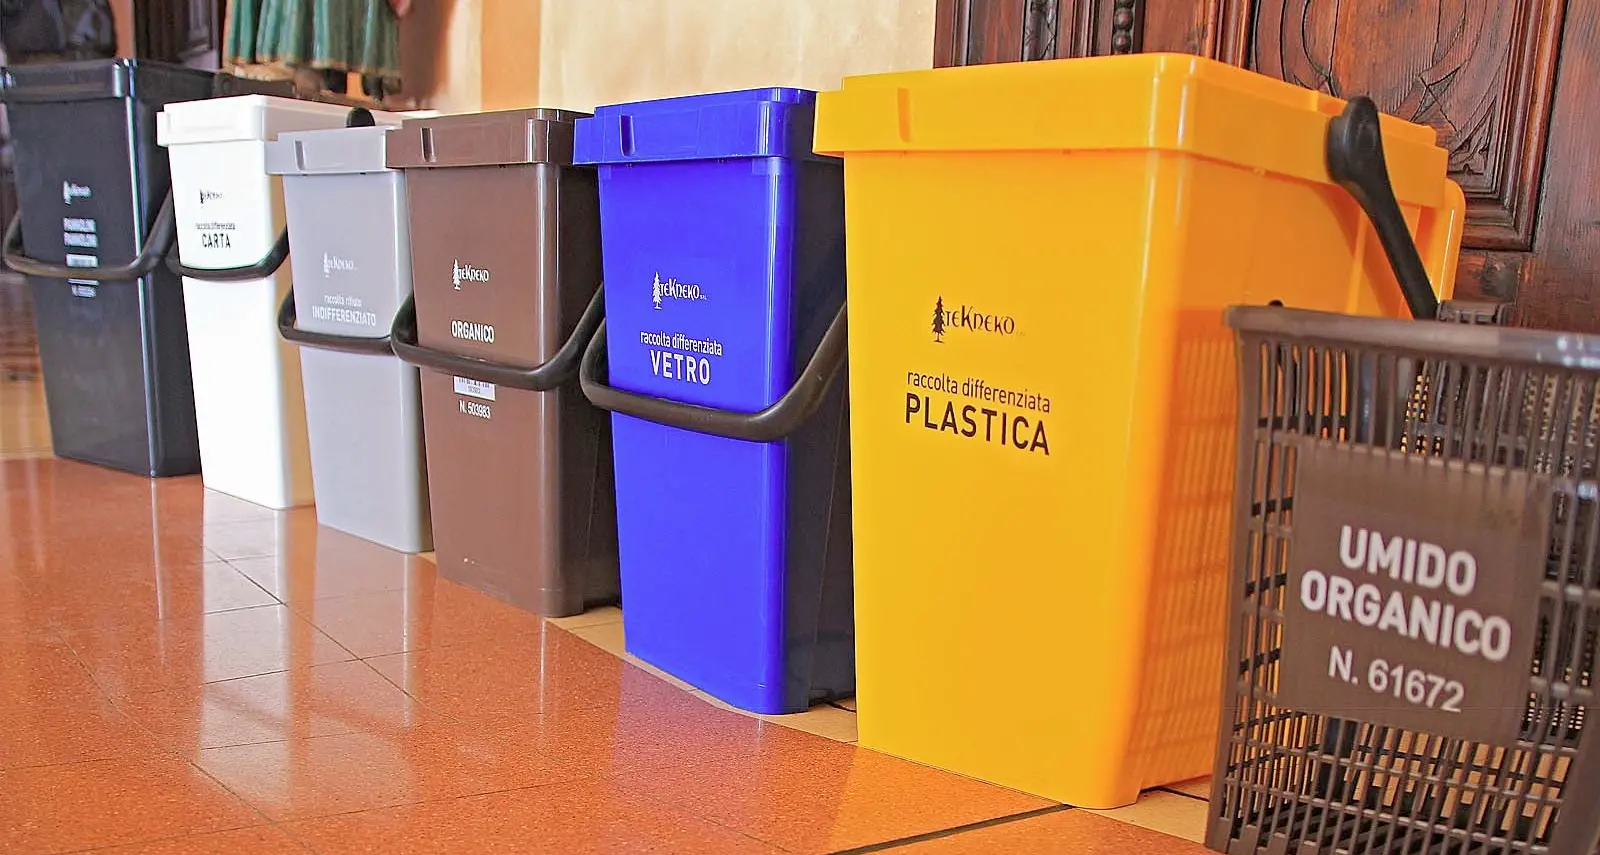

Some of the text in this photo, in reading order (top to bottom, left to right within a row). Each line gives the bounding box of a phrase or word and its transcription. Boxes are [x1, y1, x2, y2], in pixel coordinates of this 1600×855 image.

[202, 233, 231, 249] CARTA
[312, 305, 377, 326] INDIFFERENZIATO
[452, 320, 495, 343] ORGANICO
[641, 331, 723, 357] raccolta differenziata
[650, 349, 710, 385] VETRO
[907, 371, 1050, 414] raccolta differenziata
[905, 392, 1050, 456] PLASTICA
[1339, 525, 1477, 597] UMIDO
[1300, 570, 1512, 662] ORGANICO
[1328, 645, 1466, 713] N. 61672
